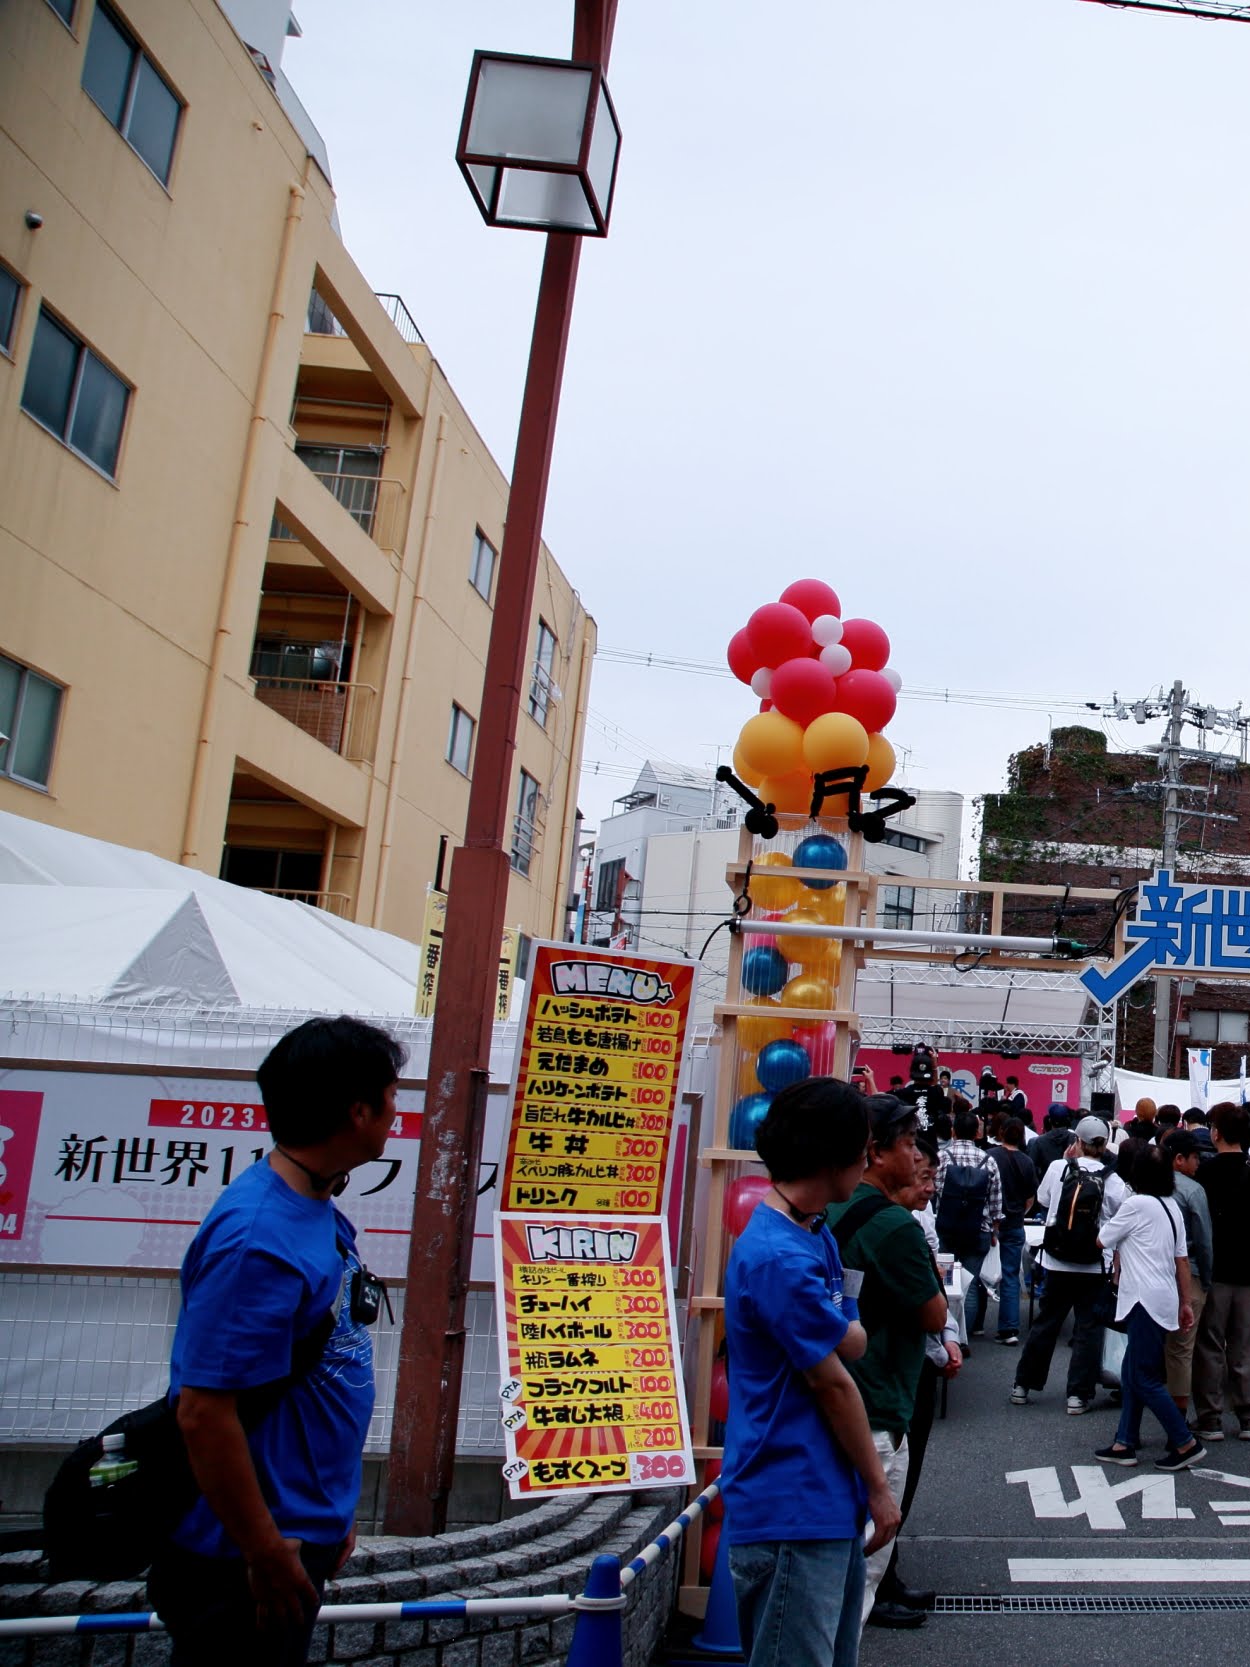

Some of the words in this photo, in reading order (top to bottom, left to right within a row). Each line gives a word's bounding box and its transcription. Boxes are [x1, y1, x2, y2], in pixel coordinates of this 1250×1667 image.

[552, 962, 660, 1001] MENU
[541, 999, 637, 1024] ハッシュポテト
[645, 1010, 675, 1028] 100
[537, 1025, 640, 1051] 若鳥もも唐揚げ
[646, 1037, 673, 1055] 100
[537, 1052, 609, 1076] えだまめ
[638, 1062, 668, 1081] 100
[527, 1080, 628, 1102] ハリケーンポテト
[637, 1087, 666, 1105] 100
[525, 1104, 636, 1129] 旨だれ牛カルビ丼
[640, 1112, 666, 1131] 300
[528, 1131, 589, 1155] 牛丼
[623, 1137, 658, 1157] 300
[516, 1163, 619, 1180] イベリコ豚カルビ丼
[626, 1164, 657, 1182] 300
[516, 1187, 578, 1206] ドリンク
[620, 1189, 652, 1208] 100
[527, 1226, 637, 1261] KIRIN
[619, 1268, 656, 1287] 300
[520, 1295, 592, 1314] チューハイ
[622, 1294, 660, 1314] 300
[521, 1320, 611, 1340] 陸ハイボール
[624, 1320, 662, 1340] 300
[525, 1348, 599, 1370] 瓶ラムネ
[631, 1348, 667, 1368] 200
[501, 1381, 521, 1398] PTA
[526, 1376, 632, 1397] フランクフルト
[640, 1375, 671, 1393] 100
[504, 1409, 525, 1428] PTA
[639, 1402, 673, 1421] 400
[642, 1427, 676, 1447] 200
[504, 1461, 527, 1479] PTA
[532, 1455, 628, 1483] もずくスープ
[636, 1454, 686, 1480] 300
